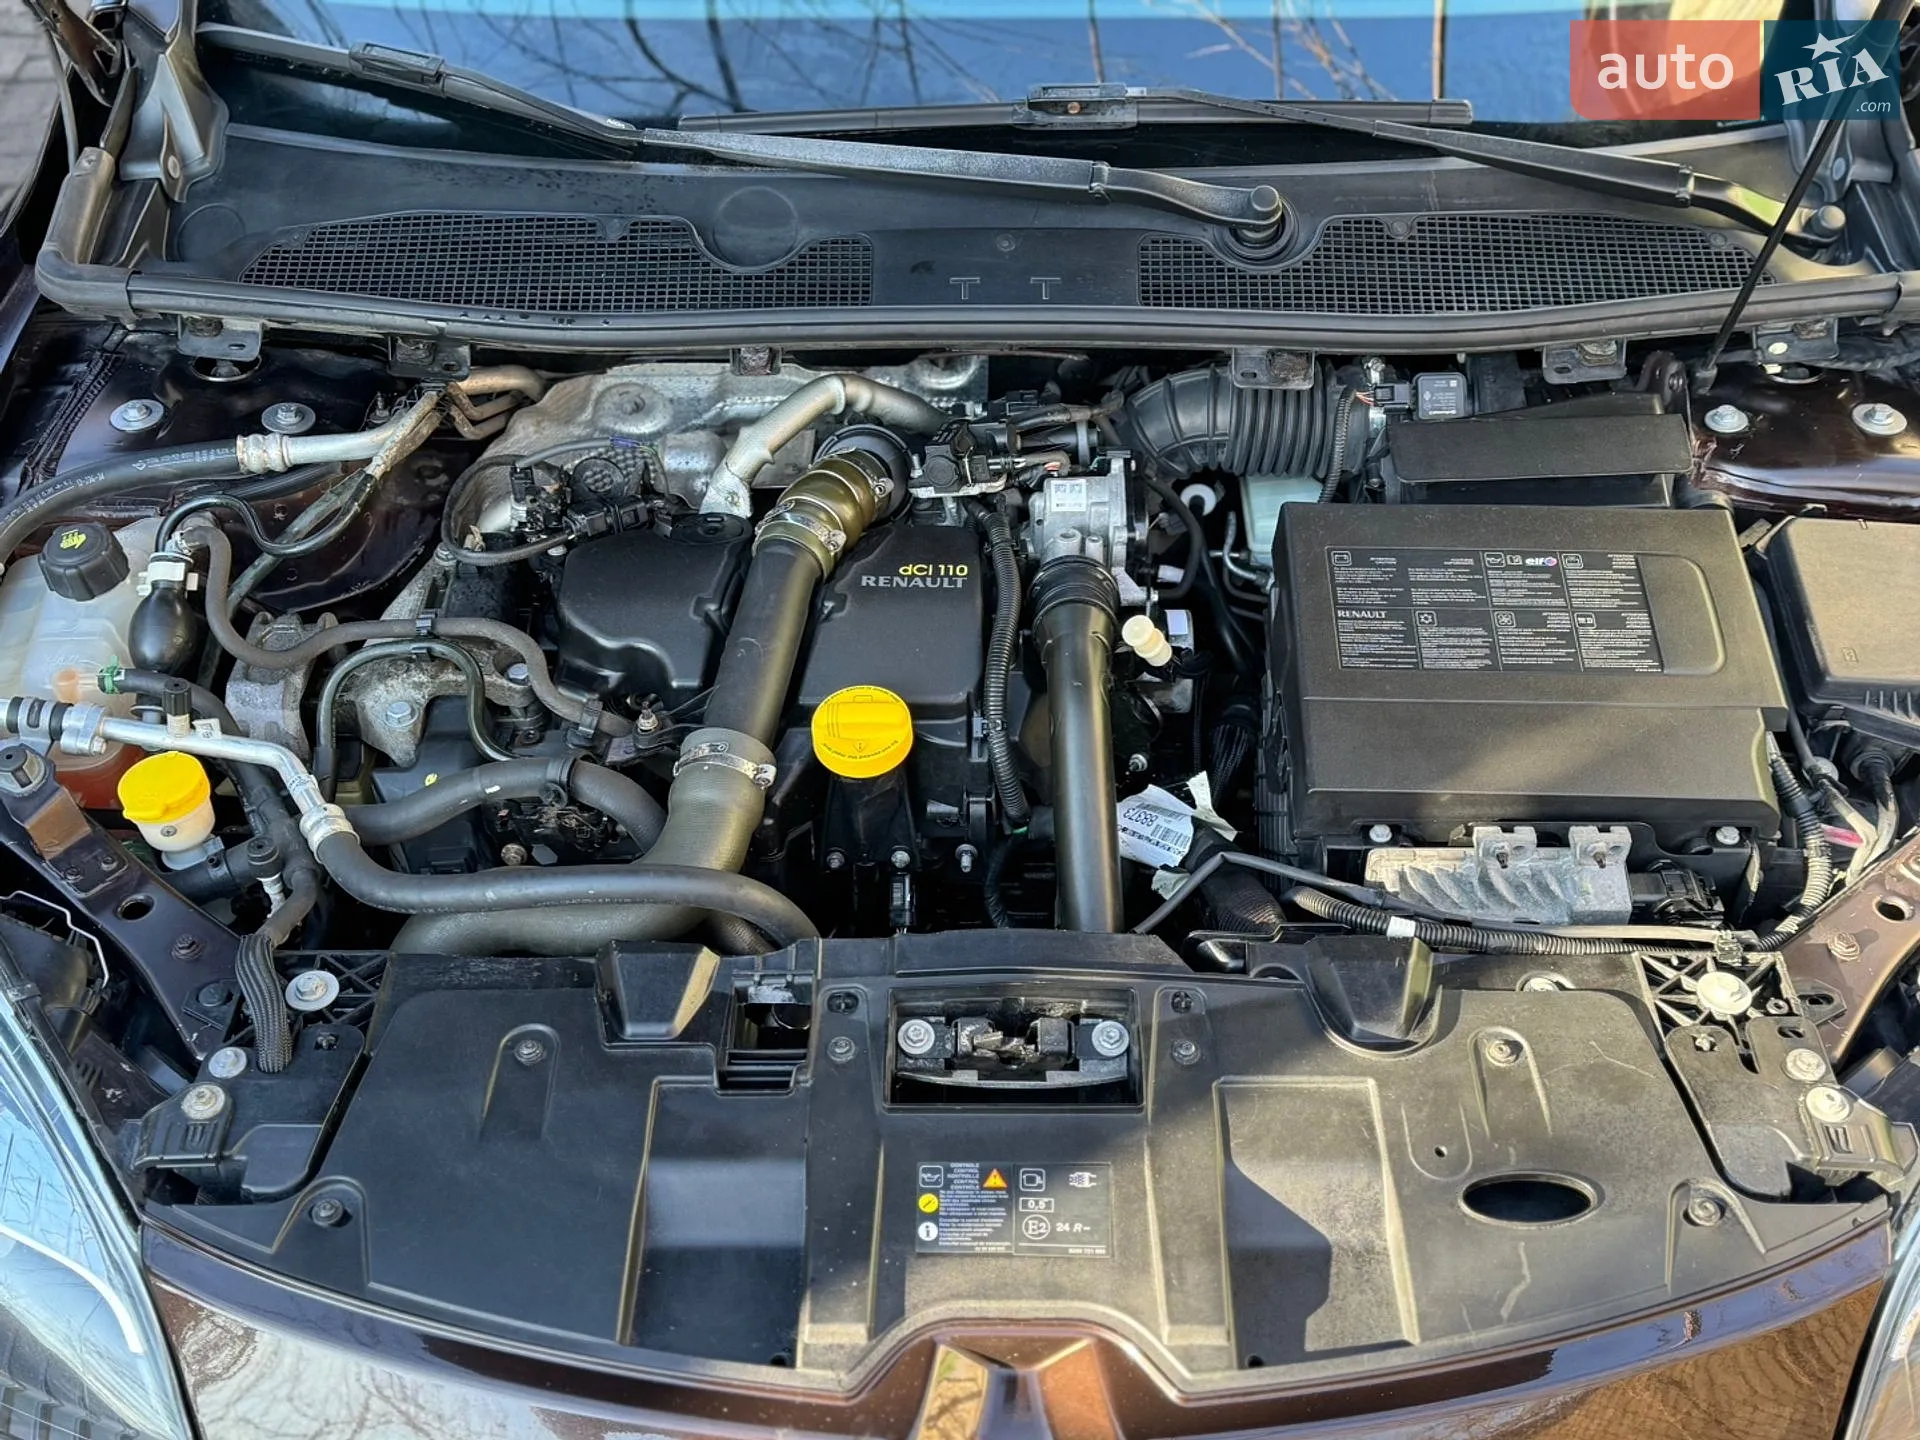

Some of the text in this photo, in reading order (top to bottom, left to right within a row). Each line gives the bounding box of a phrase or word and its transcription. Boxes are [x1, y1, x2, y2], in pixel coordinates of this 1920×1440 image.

[1525, 556, 1545, 567] elf
[938, 564, 969, 576] 110
[861, 575, 968, 588] RENAULT
[1337, 609, 1388, 619] RENAULT
[1027, 1220, 1047, 1235] E2
